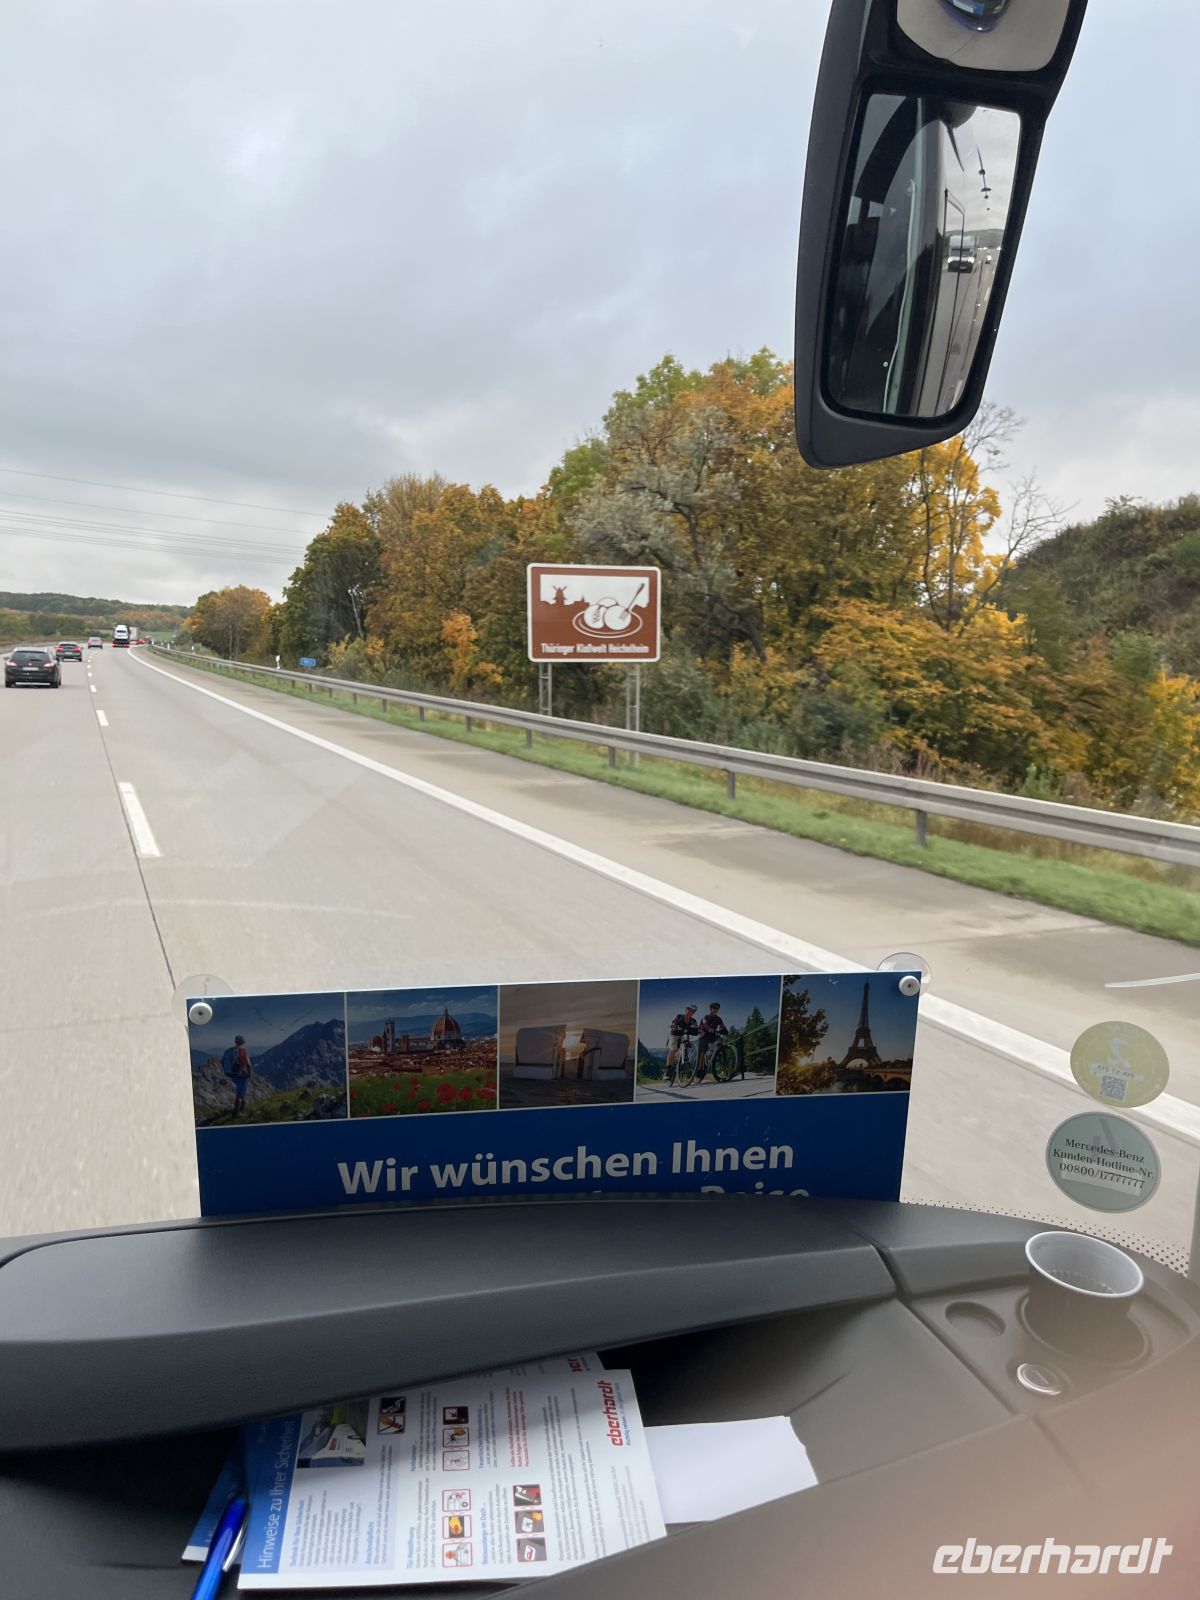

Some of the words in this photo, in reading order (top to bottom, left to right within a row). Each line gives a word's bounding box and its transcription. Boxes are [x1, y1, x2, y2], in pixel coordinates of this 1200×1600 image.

[1053, 1148, 1154, 1179] Kunden-Hotline-Nr.
[1064, 1138, 1145, 1163] Mercedes-Benz
[337, 1158, 418, 1194] Wir
[430, 1146, 658, 1188] wünschen
[672, 1140, 794, 1173] Ihnen
[597, 1380, 623, 1446] eberhardt
[269, 1471, 287, 1496] Ihrer
[270, 1499, 282, 1512] zu
[256, 1513, 279, 1568] Hinweise
